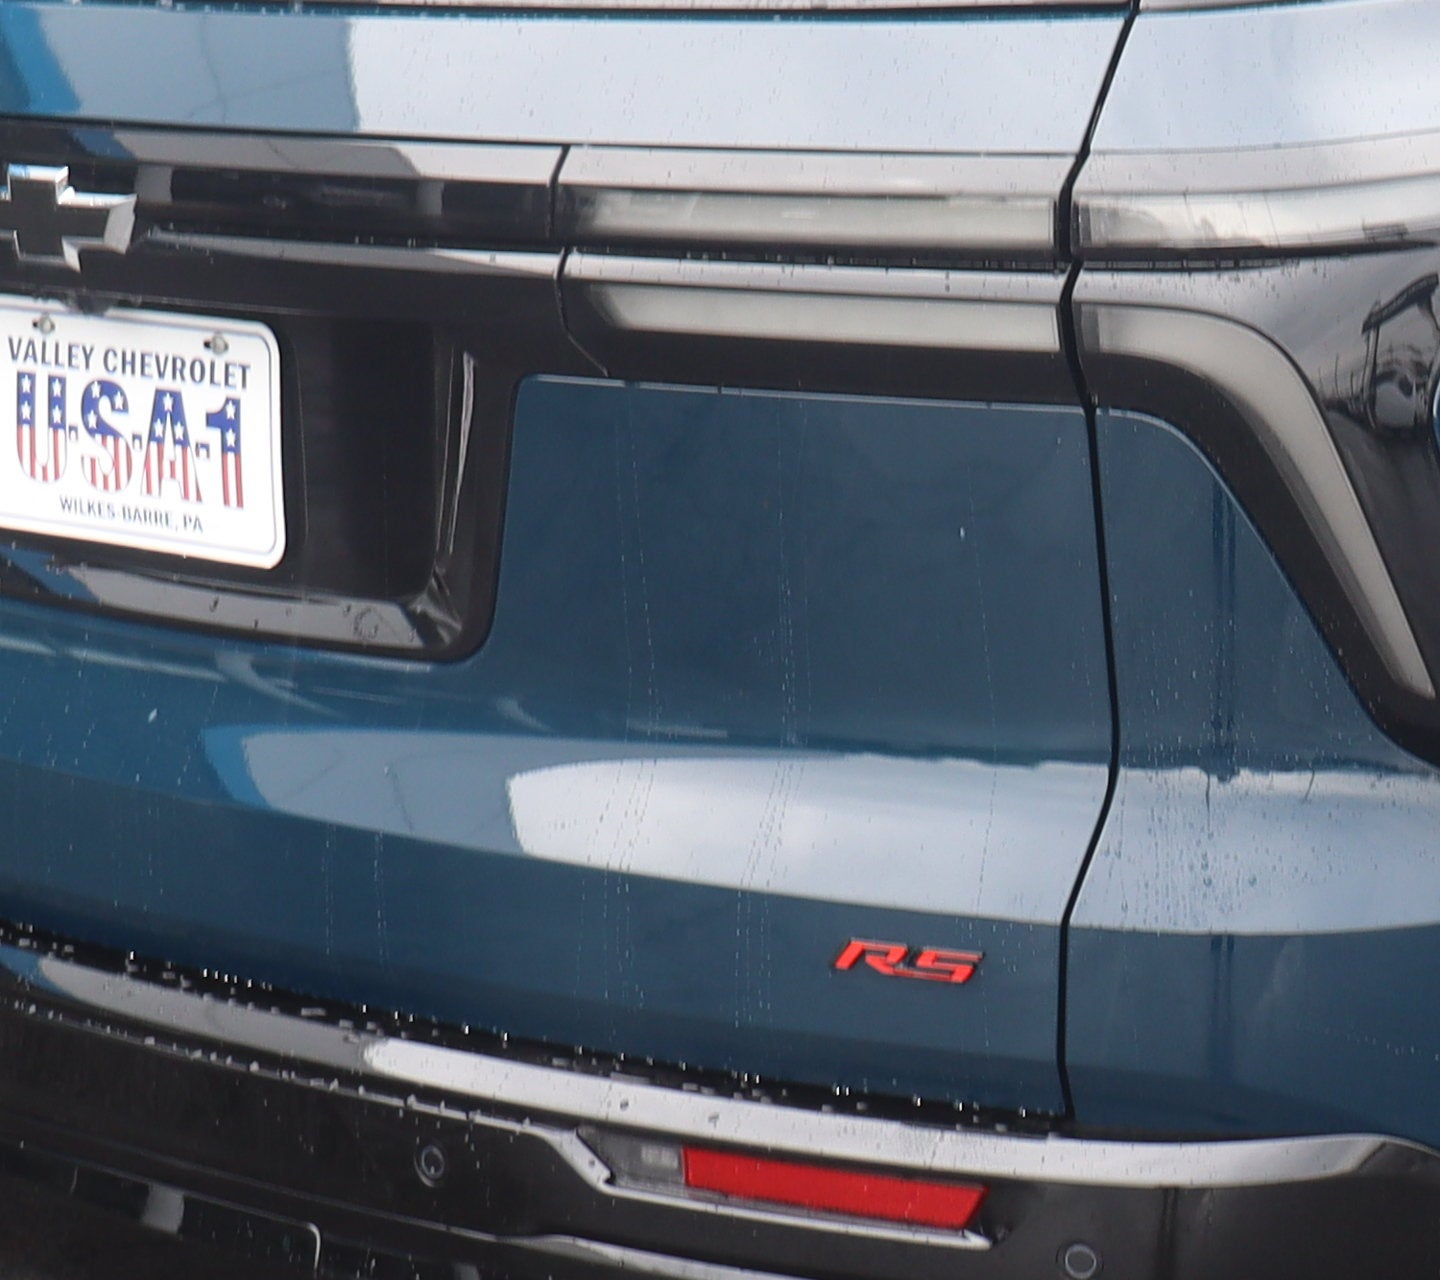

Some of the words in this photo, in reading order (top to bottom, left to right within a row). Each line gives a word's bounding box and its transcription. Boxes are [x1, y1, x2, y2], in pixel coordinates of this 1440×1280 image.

[8, 336, 95, 371] VALLEY
[103, 348, 252, 390] CHEVROLET
[183, 513, 204, 534] PA
[833, 937, 984, 984] RS
